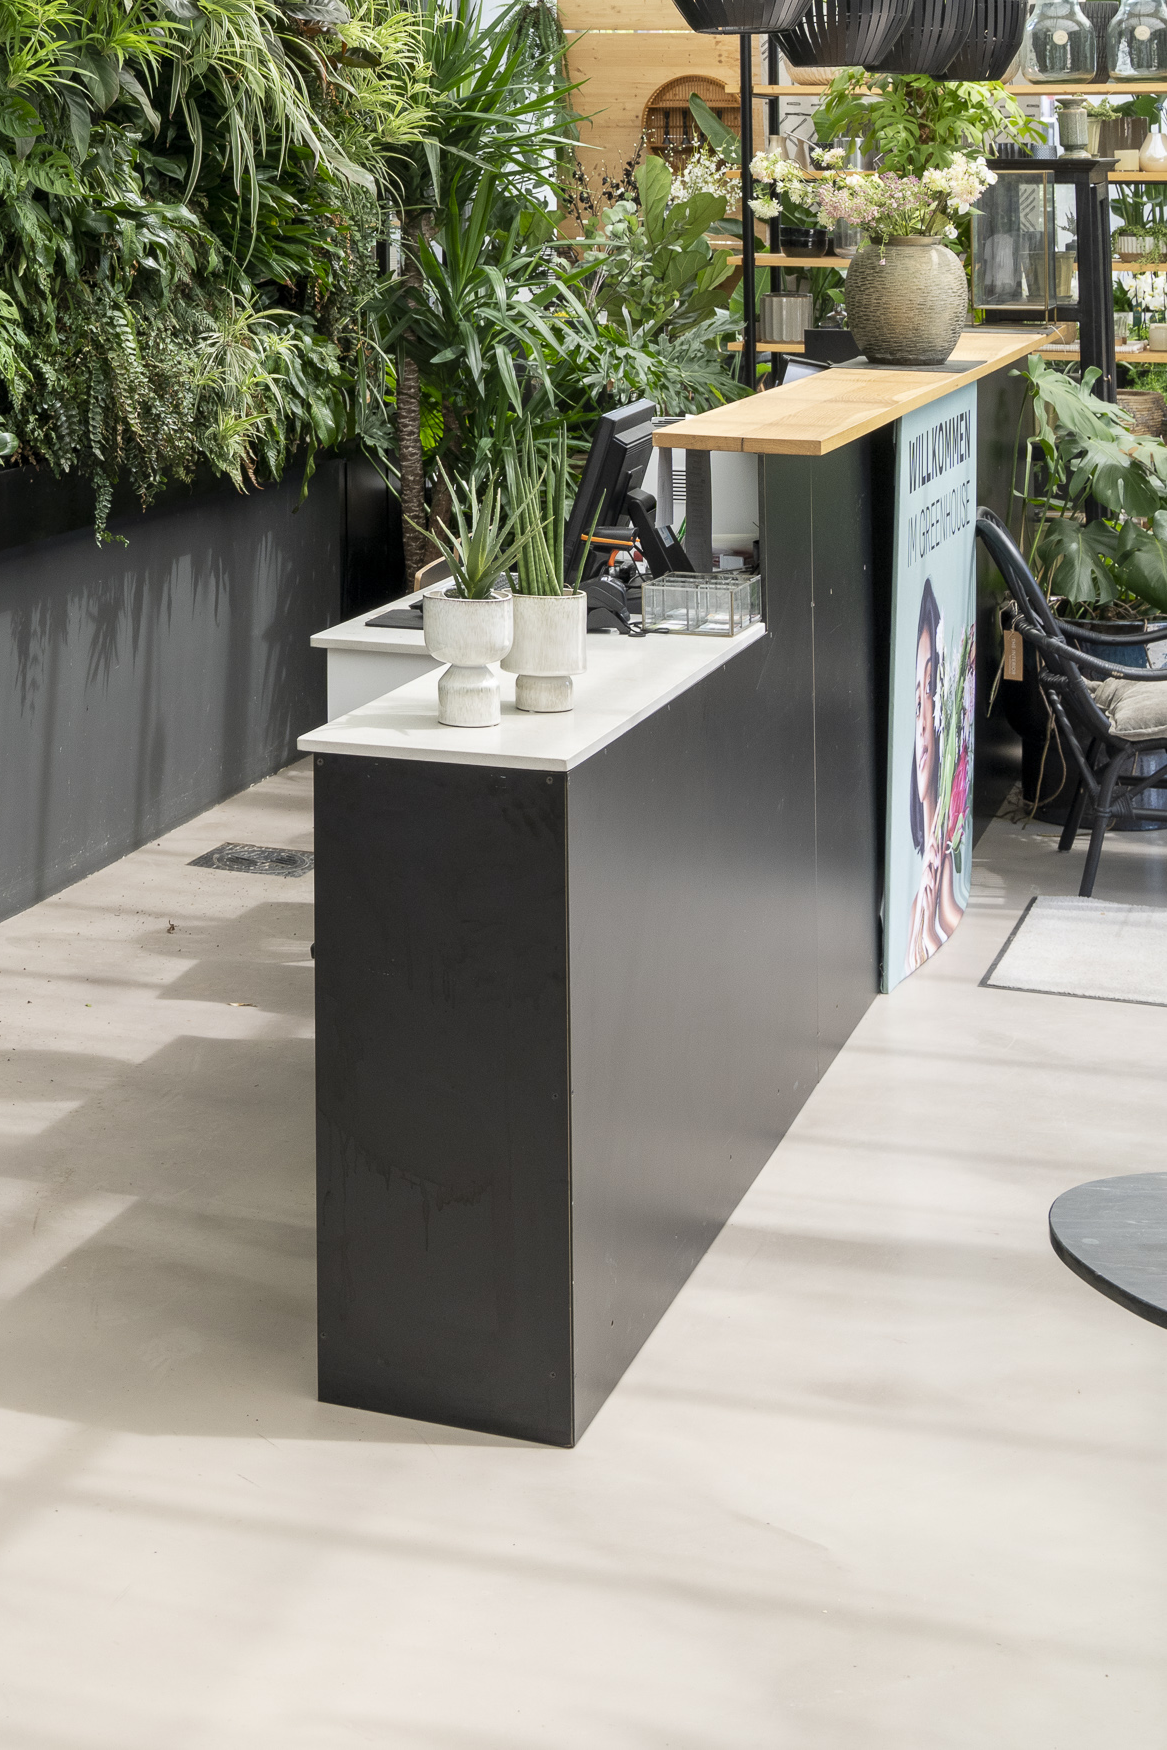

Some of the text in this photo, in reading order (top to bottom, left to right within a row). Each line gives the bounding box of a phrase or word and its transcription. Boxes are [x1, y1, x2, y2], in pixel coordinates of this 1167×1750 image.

[908, 409, 971, 495] WILLKOMMEN
[907, 479, 971, 568] IM GREENHOUSE
